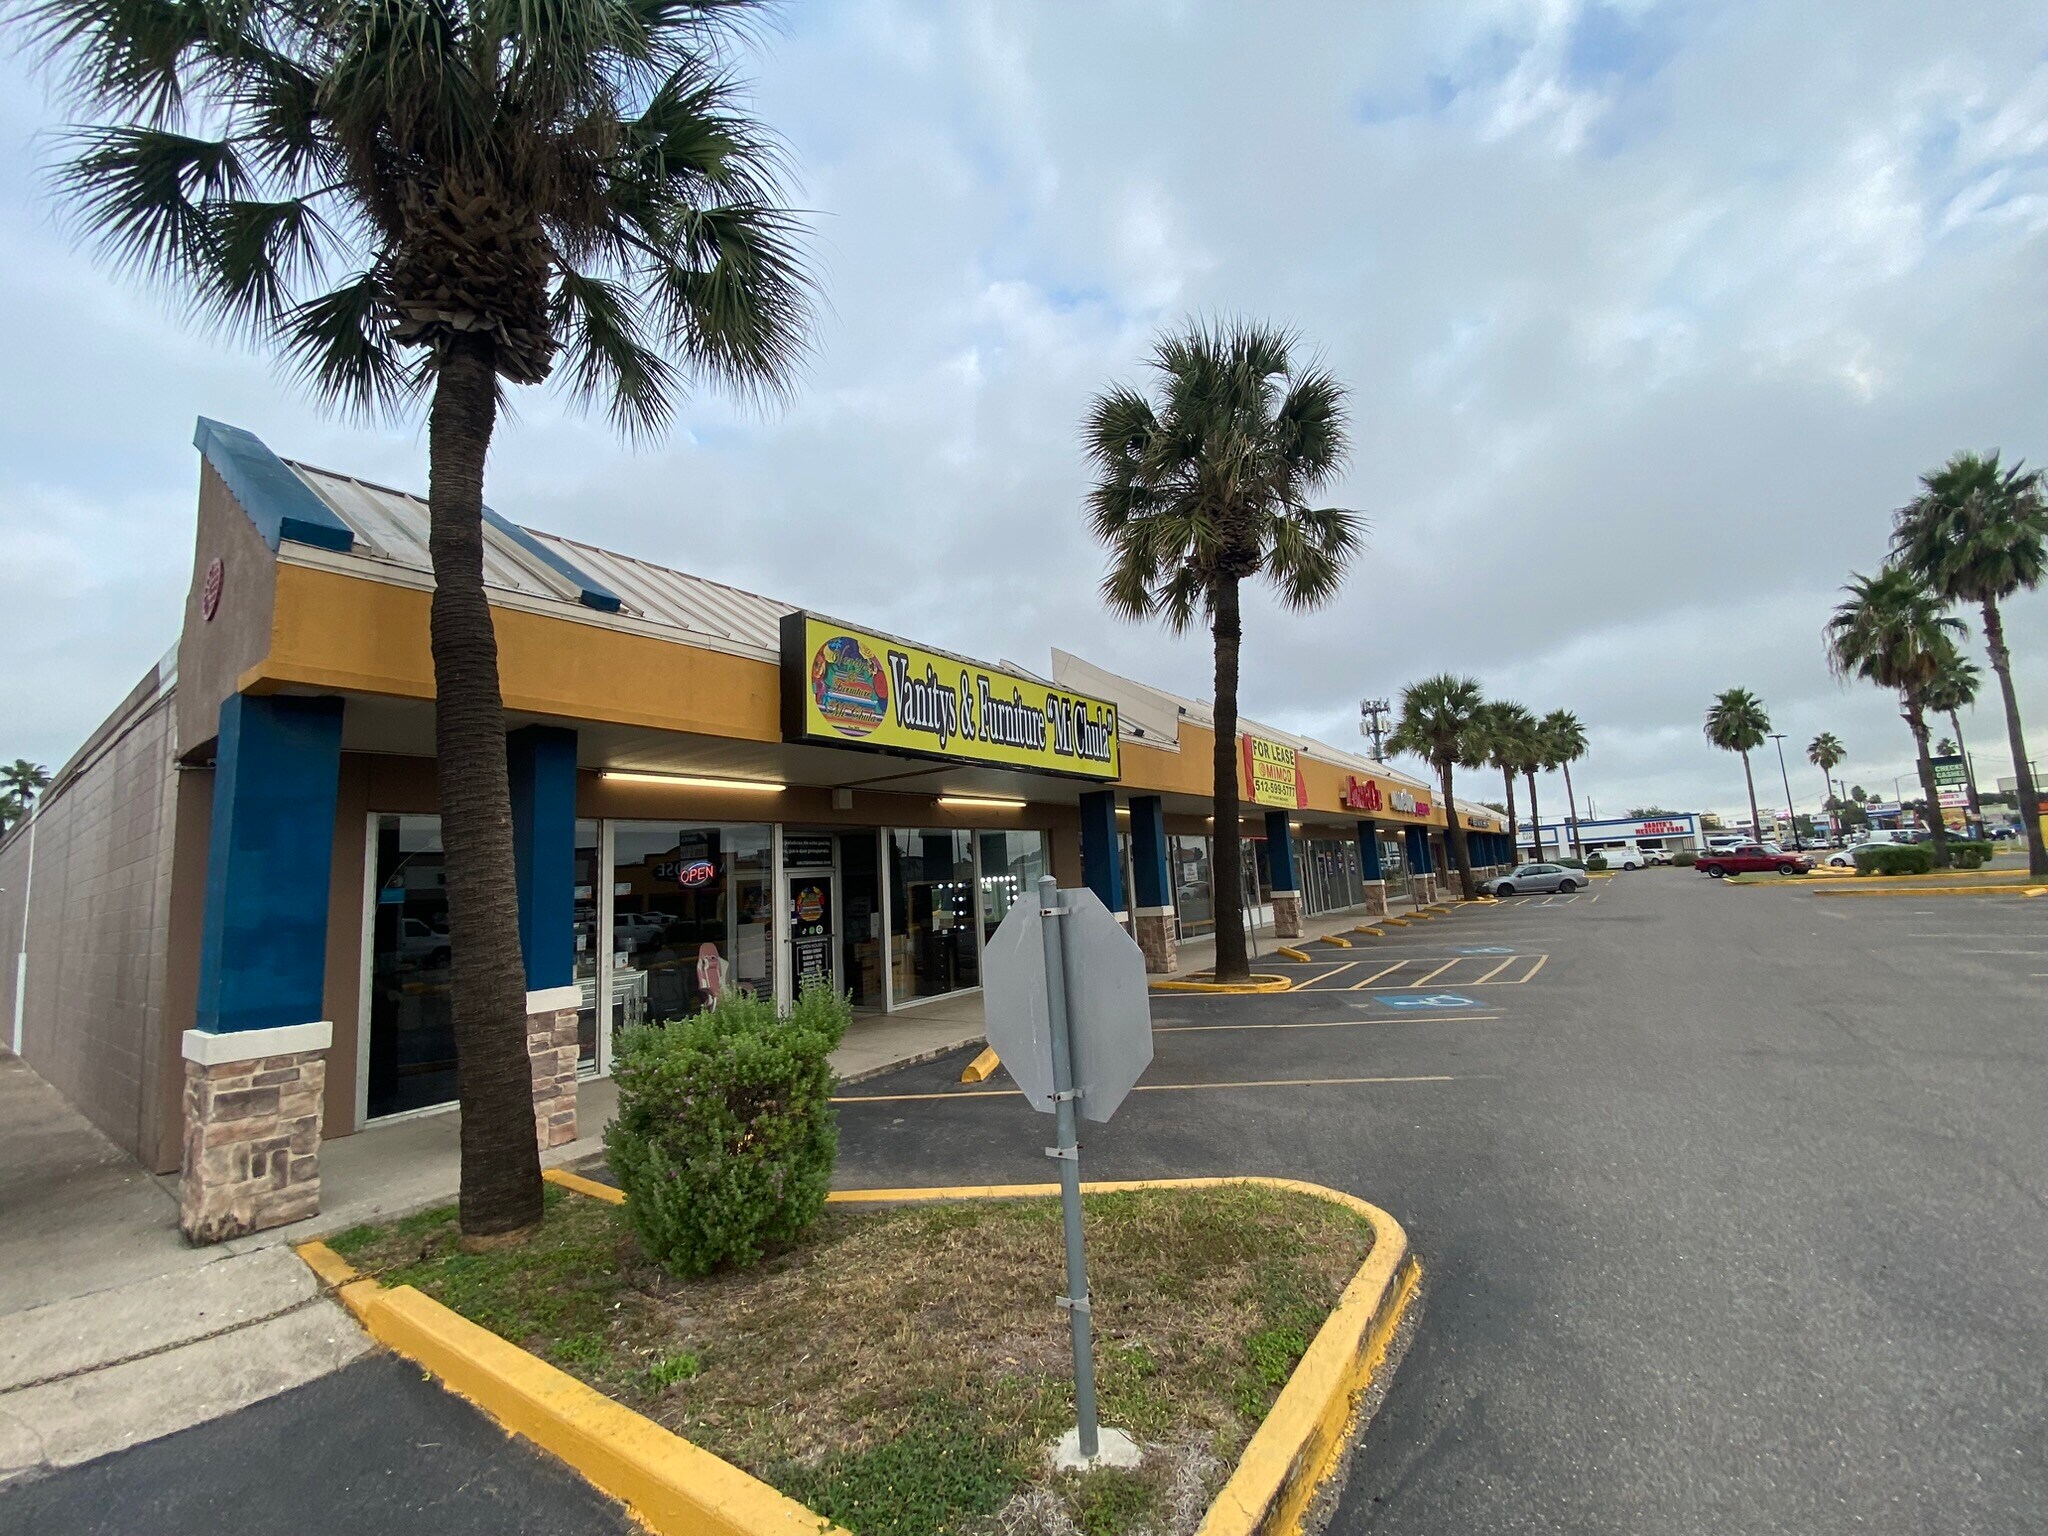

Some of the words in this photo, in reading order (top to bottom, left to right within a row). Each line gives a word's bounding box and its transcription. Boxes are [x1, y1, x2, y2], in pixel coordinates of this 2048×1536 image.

[832, 678, 872, 699] Furniture
[888, 651, 957, 748] Vanitys
[961, 670, 975, 739] &
[977, 676, 1046, 749] Furniture
[1252, 740, 1270, 760] FOR
[1271, 745, 1295, 766] LEASE
[1266, 764, 1292, 783] MIMCO
[1255, 780, 1295, 798] 512-599-5777
[680, 864, 714, 883] OPEN
